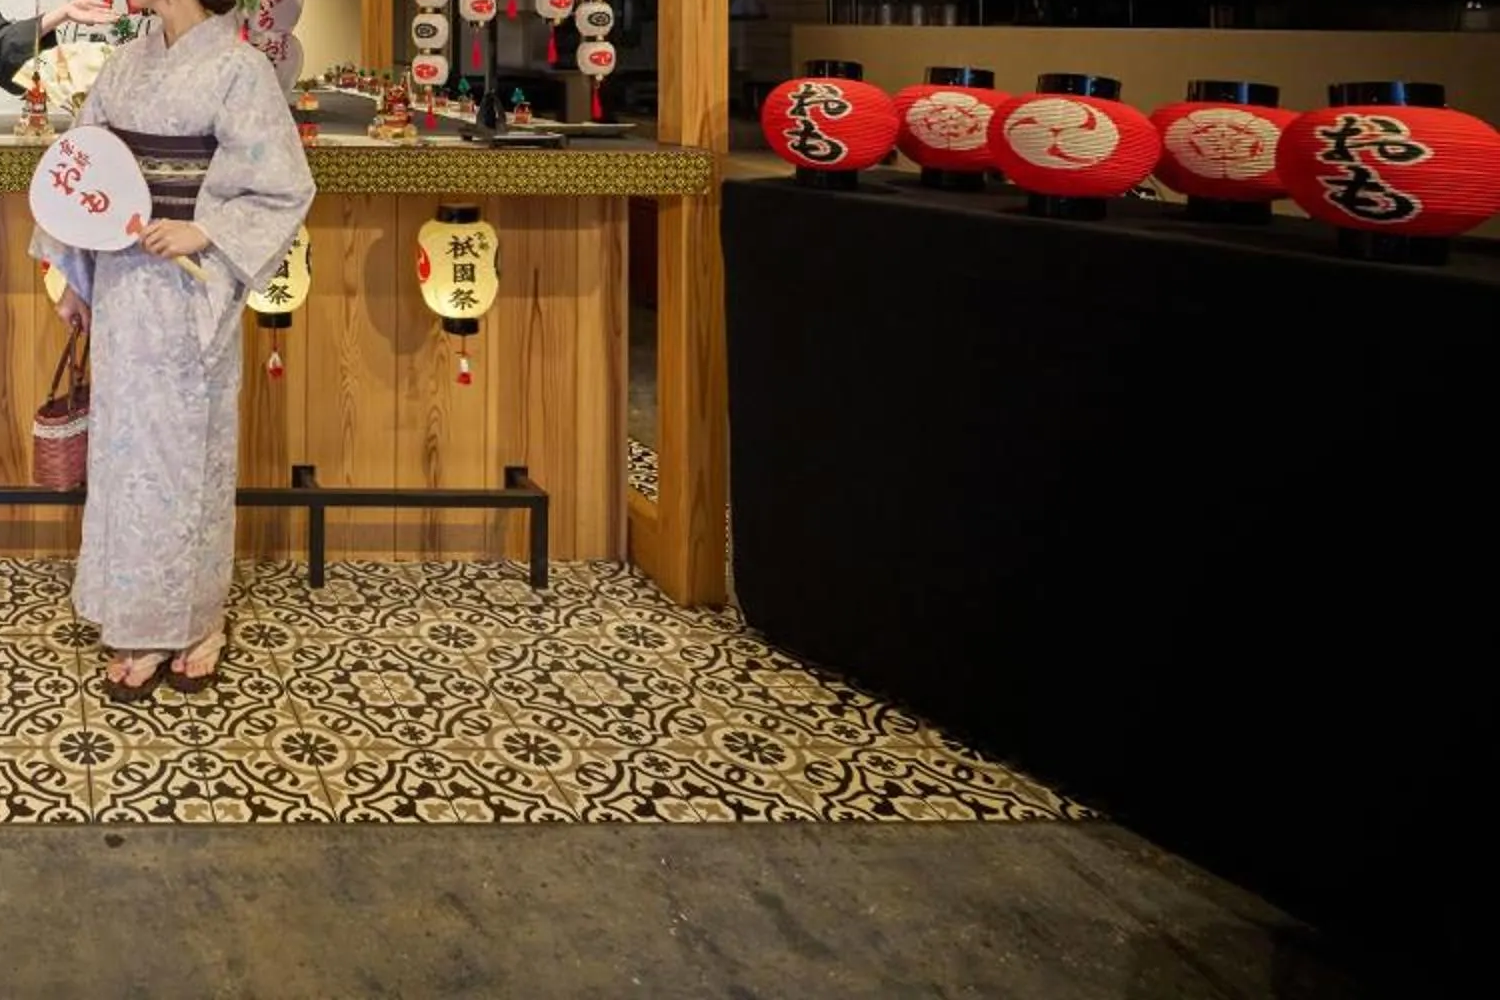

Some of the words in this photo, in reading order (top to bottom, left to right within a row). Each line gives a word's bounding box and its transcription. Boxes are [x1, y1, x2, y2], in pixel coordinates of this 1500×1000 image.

[786, 82, 852, 165] おも
[1316, 113, 1435, 224] おも
[445, 235, 480, 311] 祇園祭
